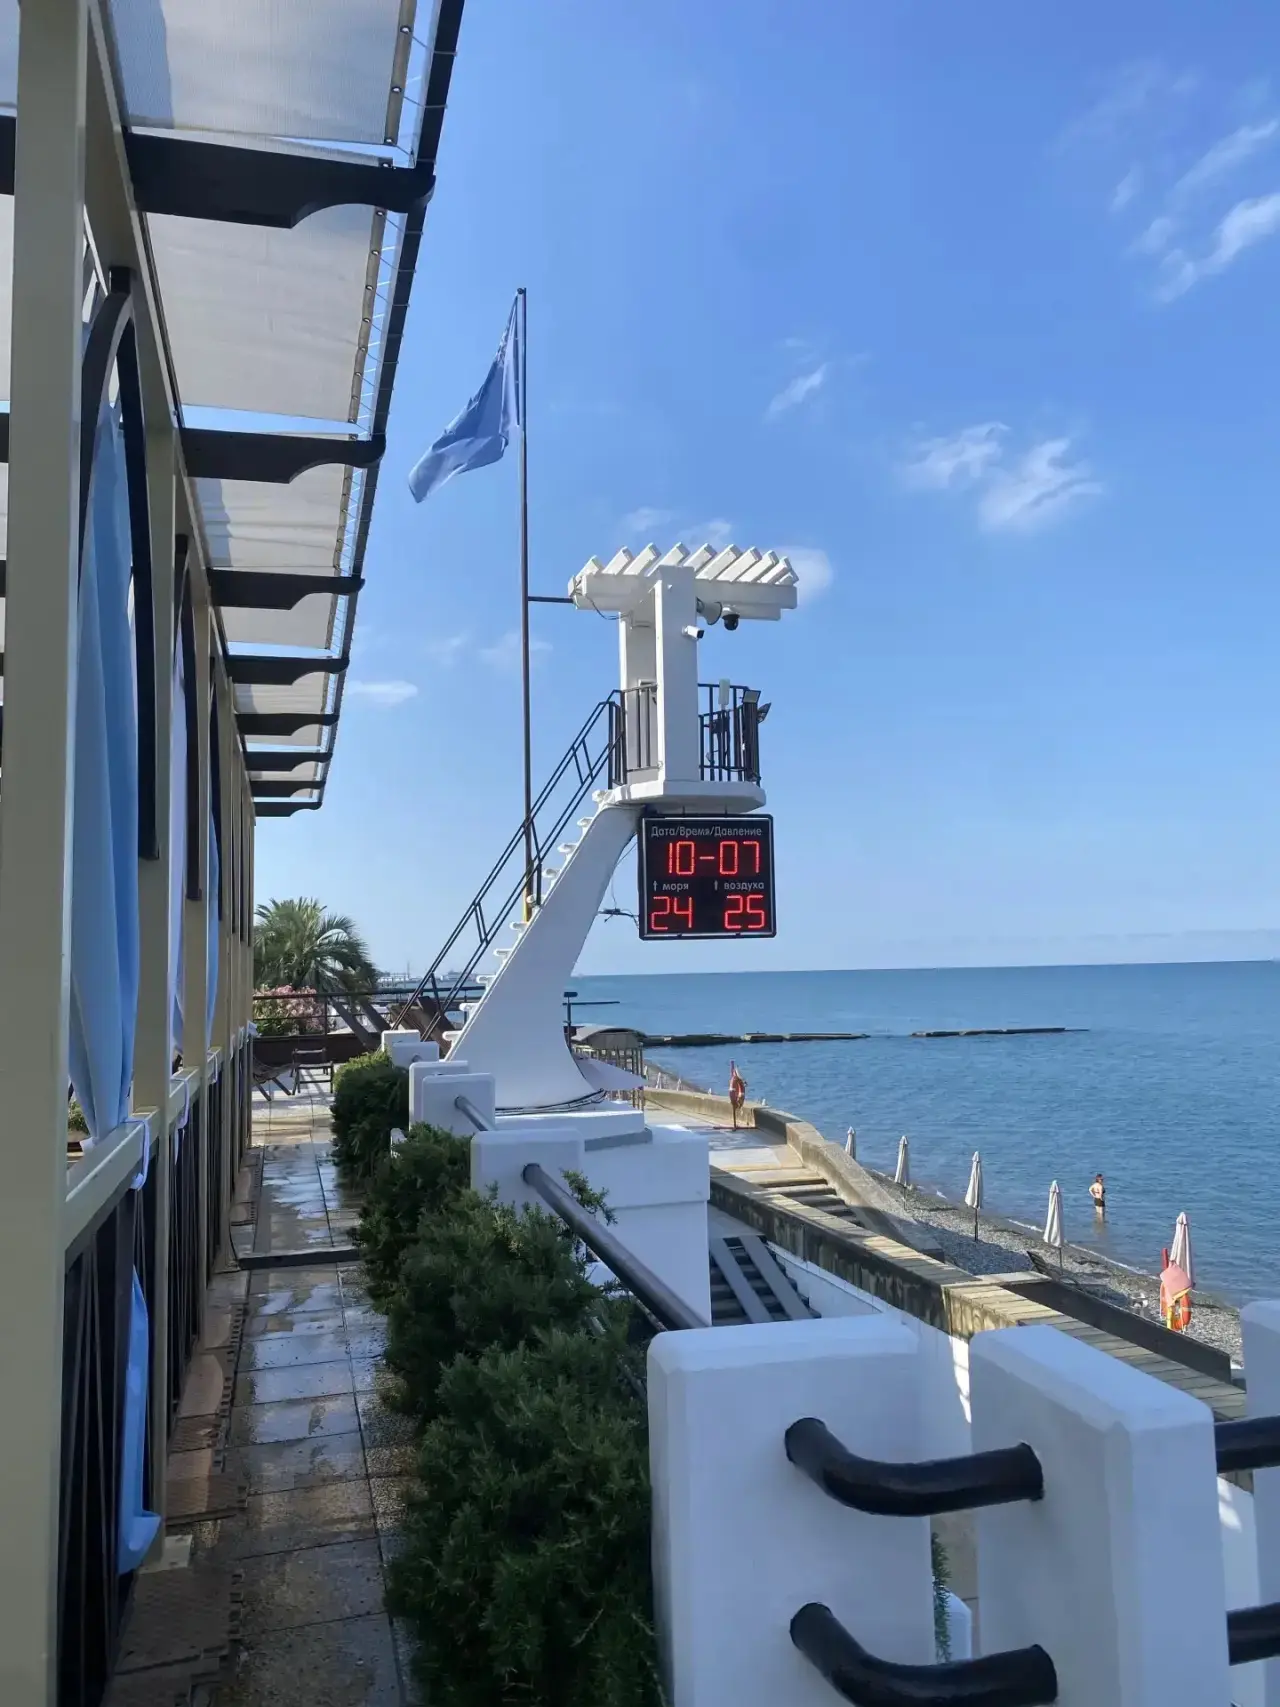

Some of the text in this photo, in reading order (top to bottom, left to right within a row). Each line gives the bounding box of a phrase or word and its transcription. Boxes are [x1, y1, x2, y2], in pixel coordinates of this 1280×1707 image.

[651, 826, 762, 838] Дата/Время/Давление
[669, 841, 760, 875] 10-07
[662, 882, 689, 892] моря
[724, 882, 765, 893] воздуха
[651, 896, 692, 930] 24
[724, 895, 765, 929] 25
